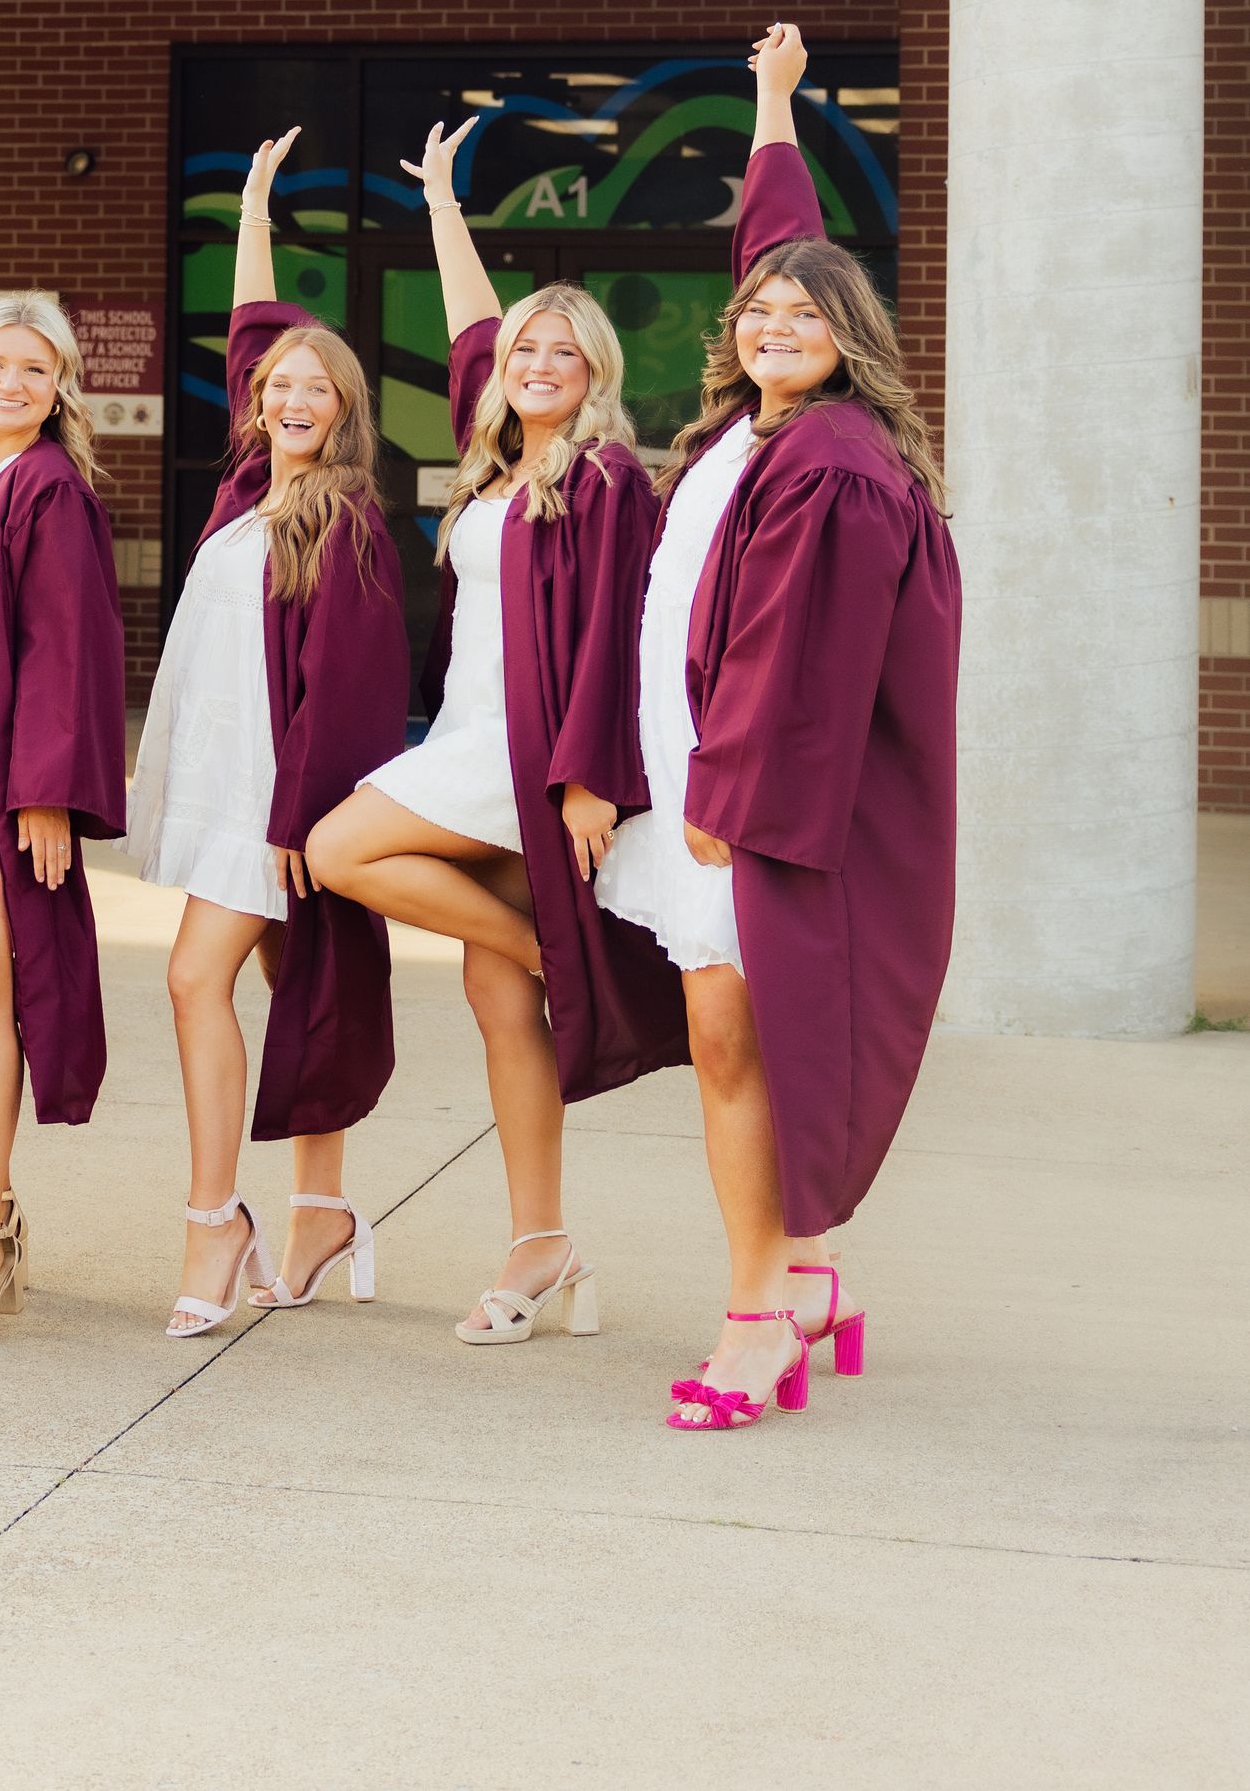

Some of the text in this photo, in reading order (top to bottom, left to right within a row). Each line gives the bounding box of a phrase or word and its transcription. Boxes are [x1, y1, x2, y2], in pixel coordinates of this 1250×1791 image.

[525, 175, 588, 218] A1
[80, 309, 153, 325] THIS SCHOOL
[91, 325, 157, 342] PROTECTED
[96, 342, 105, 356] A
[108, 342, 153, 357] SCHOOL
[85, 357, 146, 373] RESOURCE
[91, 372, 140, 388] OFFICER
